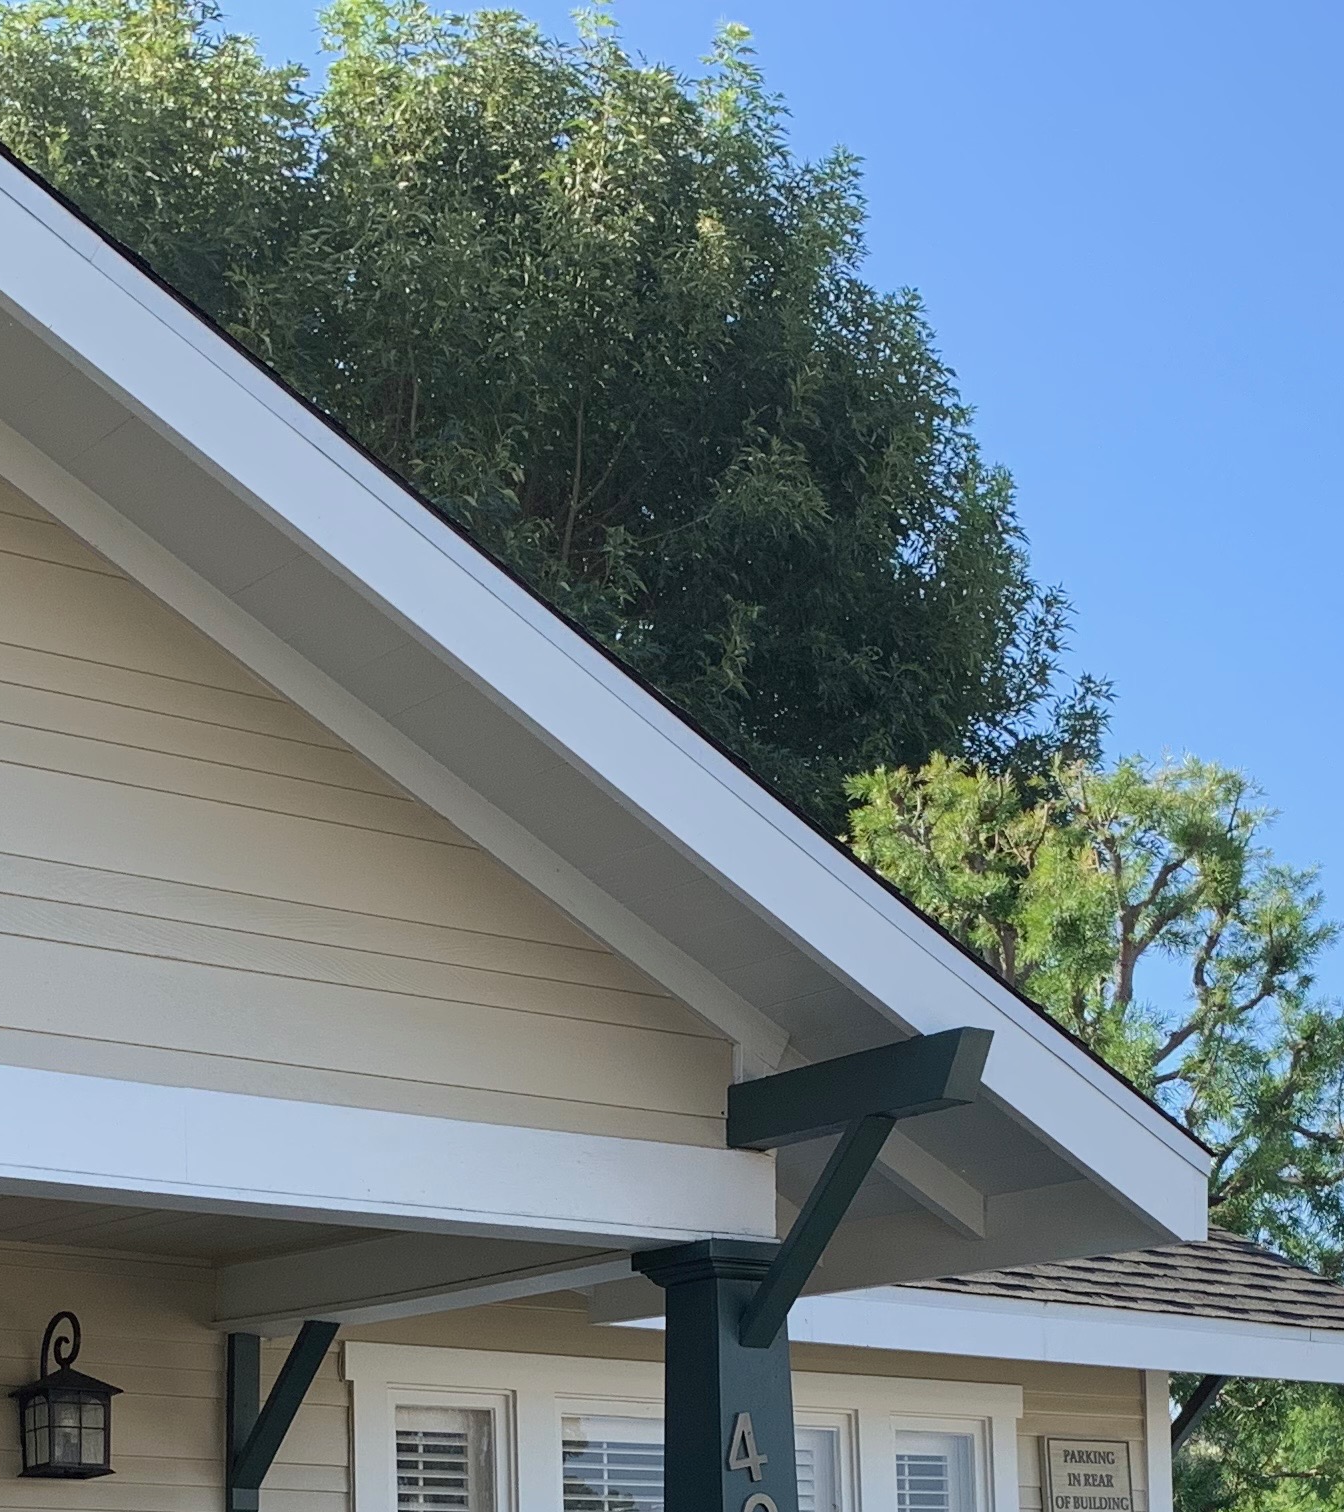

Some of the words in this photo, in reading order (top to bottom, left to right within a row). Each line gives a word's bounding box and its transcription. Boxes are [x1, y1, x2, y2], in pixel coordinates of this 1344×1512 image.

[1063, 1449, 1116, 1465] PARKING
[1067, 1472, 1082, 1487] IN
[1083, 1473, 1114, 1488] REAR
[1055, 1495, 1071, 1510] OF
[1073, 1496, 1130, 1511] BUILDING
